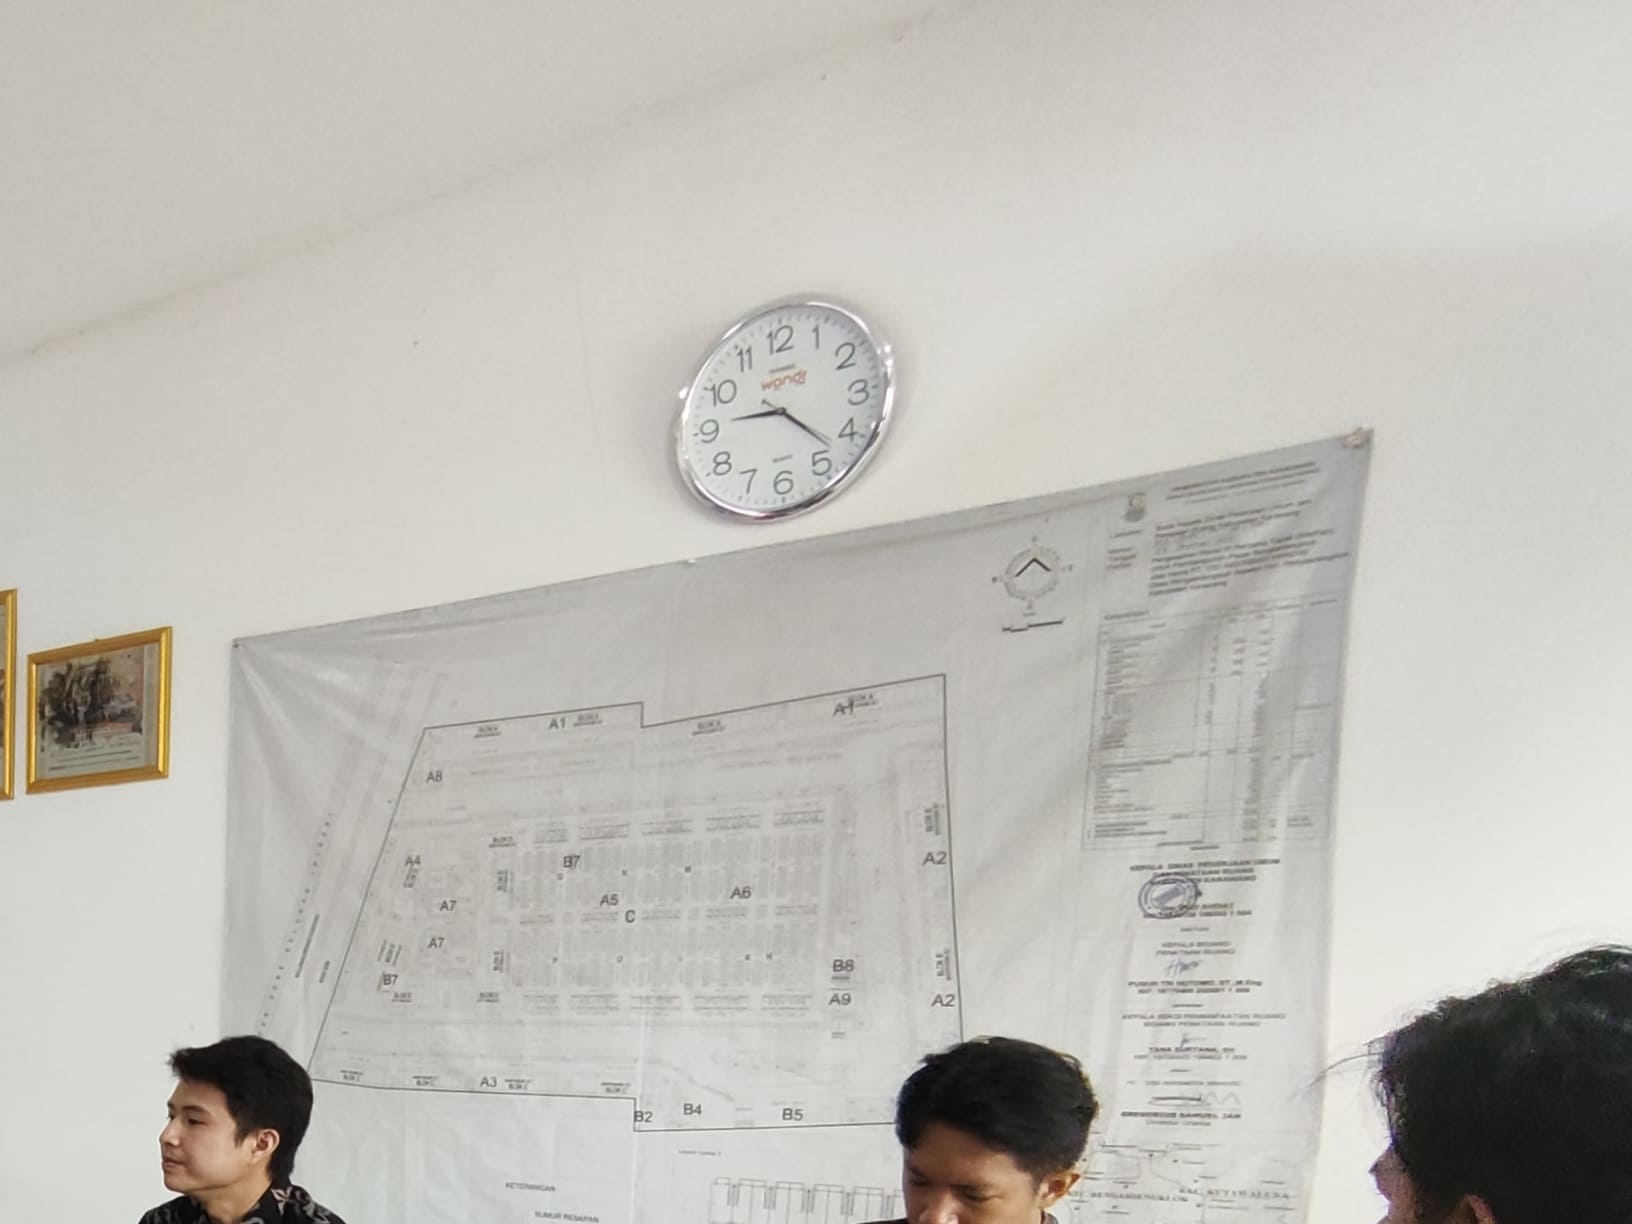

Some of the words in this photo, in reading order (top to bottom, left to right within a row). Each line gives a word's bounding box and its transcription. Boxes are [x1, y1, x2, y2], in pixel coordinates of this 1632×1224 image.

[766, 325, 795, 355] 12
[811, 324, 820, 350] 1
[736, 345, 753, 373] 11
[835, 341, 857, 370] 2
[710, 379, 738, 406] 10
[847, 378, 870, 405] 3
[699, 418, 720, 443] 9
[837, 417, 858, 442] 4
[713, 451, 733, 476] 8
[811, 449, 833, 476] 5
[739, 468, 758, 494] 7
[773, 469, 794, 495] 6
[548, 716, 566, 731] A1
[426, 770, 443, 783] A8
[404, 854, 421, 866] A4
[563, 854, 581, 868] B7
[921, 851, 948, 867] A2
[599, 893, 619, 906] A5
[729, 886, 752, 900] A6
[439, 900, 457, 912] A7
[624, 909, 636, 923] C
[427, 937, 445, 949] A7
[832, 959, 855, 973] B8
[382, 974, 399, 986] B7
[829, 993, 852, 1007] A9
[931, 993, 956, 1008] A2
[479, 1077, 498, 1088] A3
[633, 1110, 653, 1123] B2
[683, 1103, 702, 1117] B4
[782, 1108, 804, 1121] B5
[505, 1182, 556, 1192] KETERANGAN
